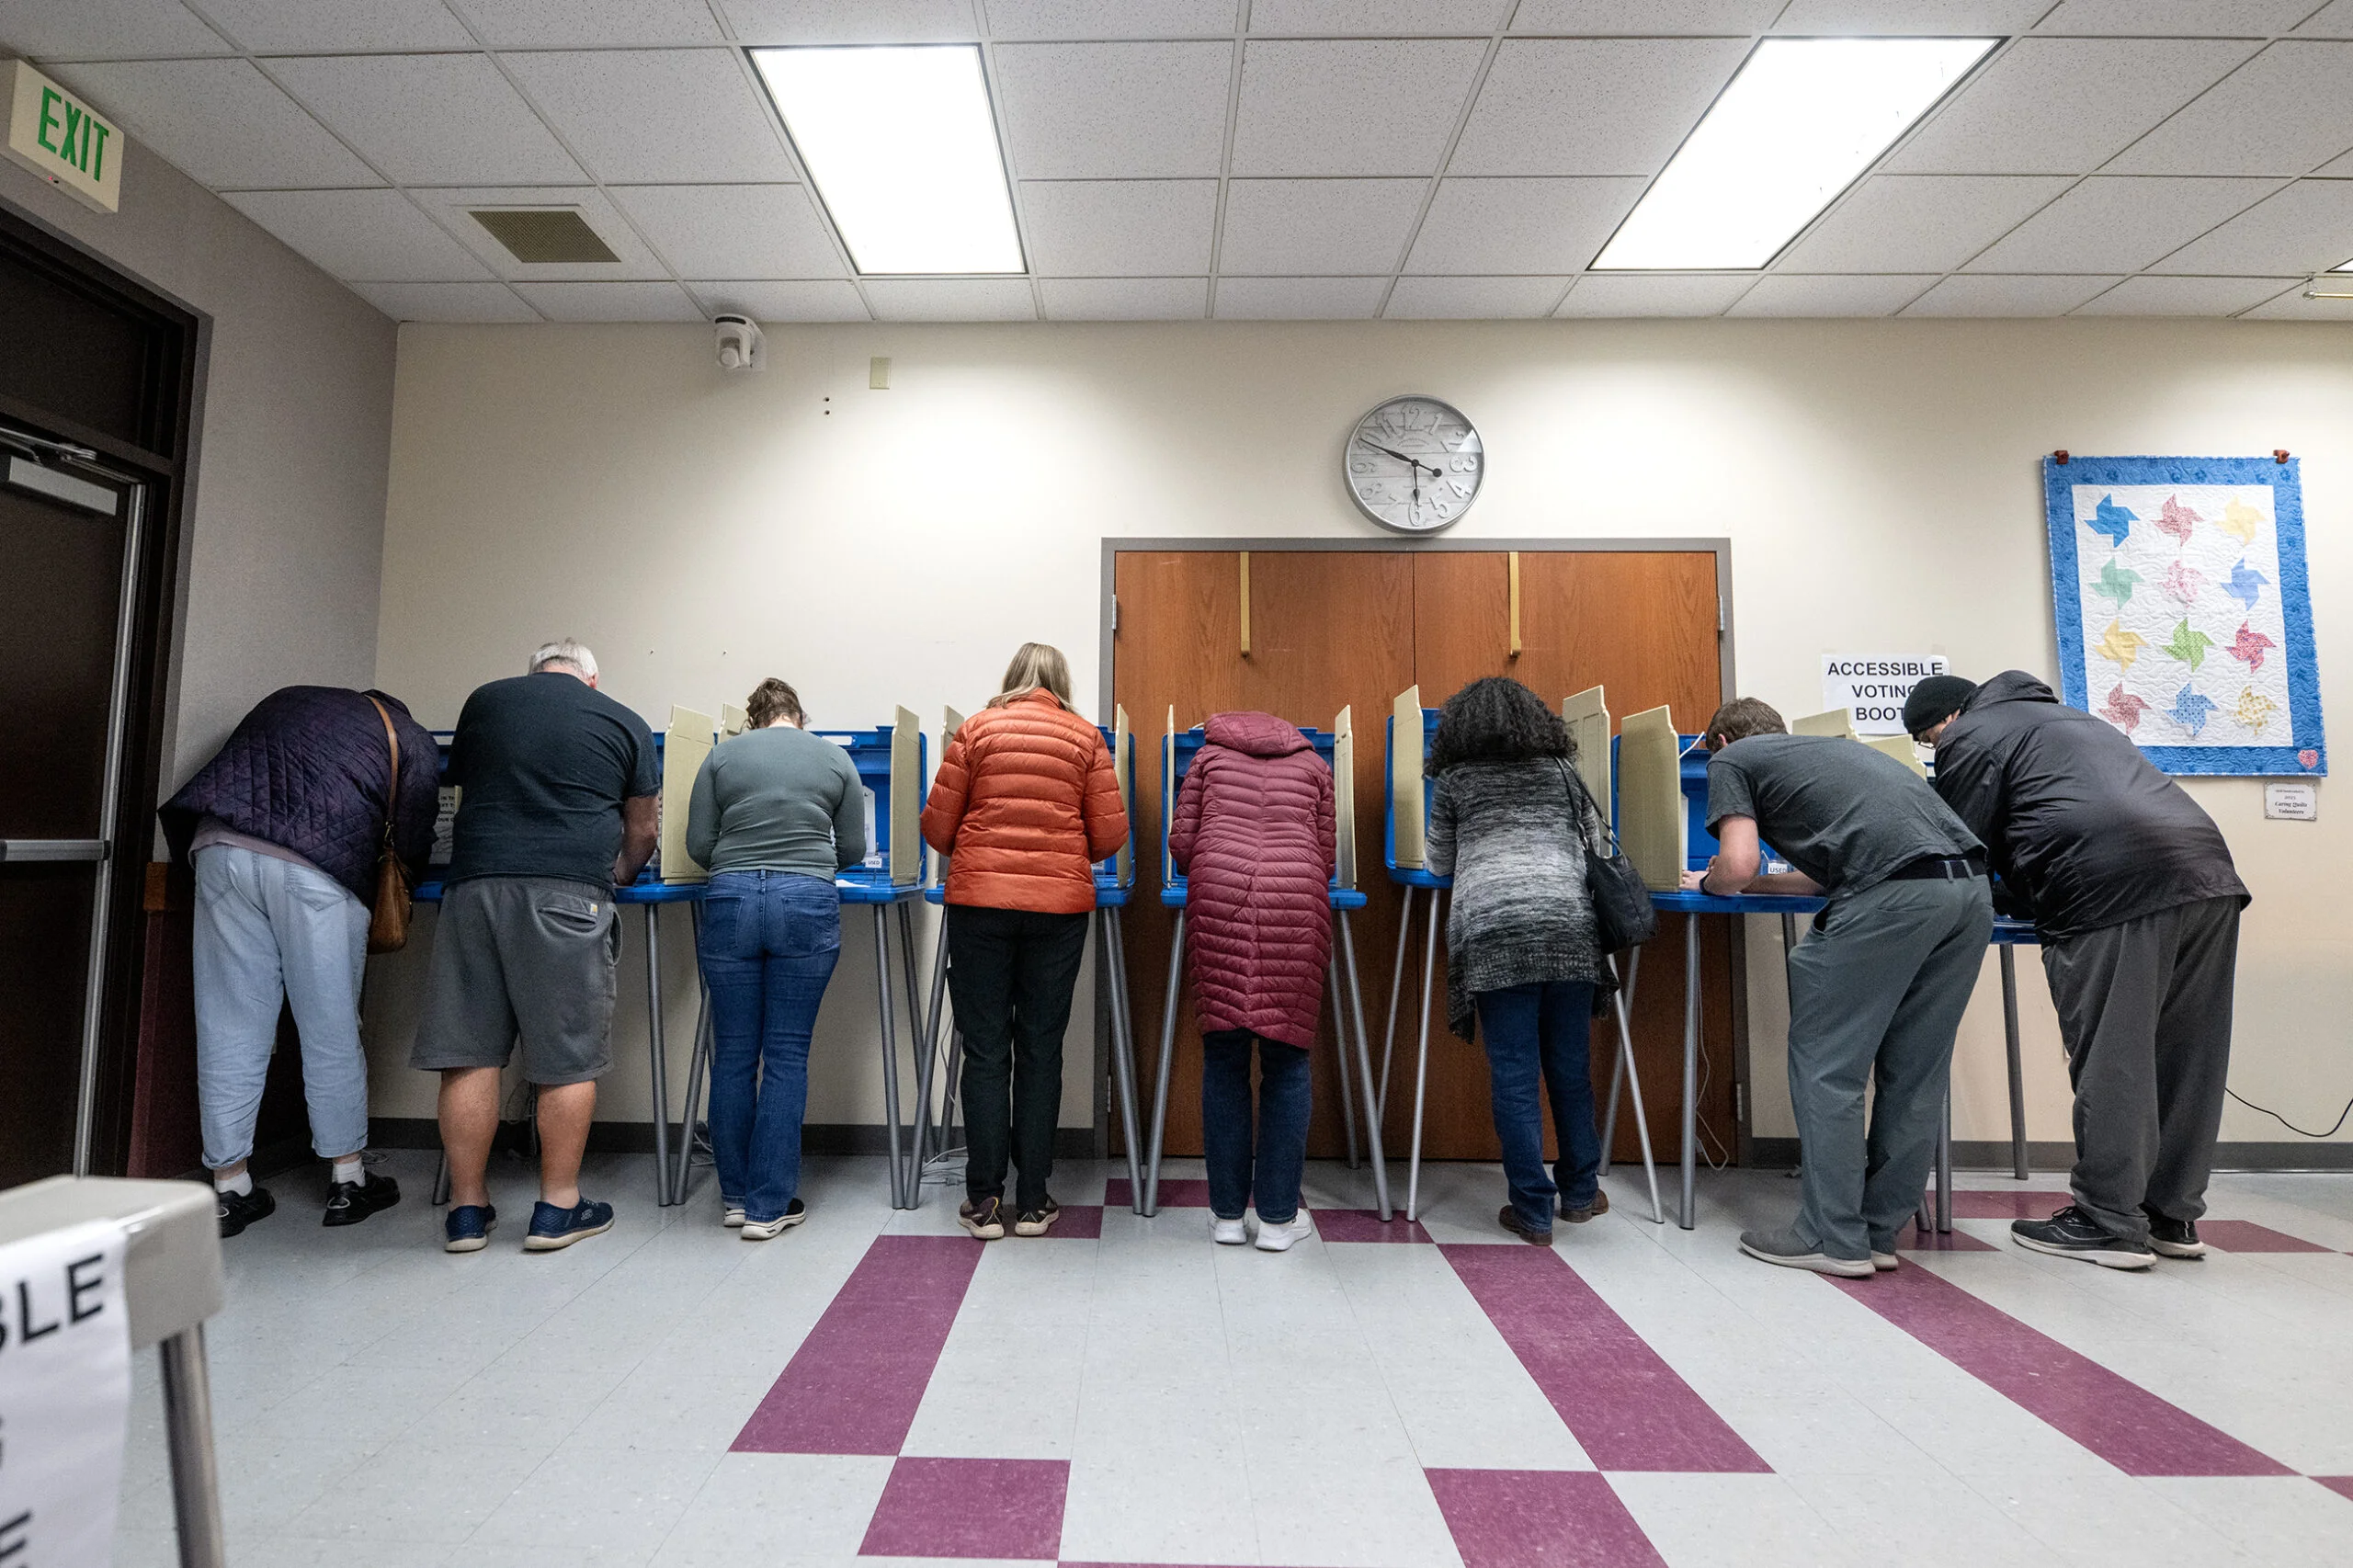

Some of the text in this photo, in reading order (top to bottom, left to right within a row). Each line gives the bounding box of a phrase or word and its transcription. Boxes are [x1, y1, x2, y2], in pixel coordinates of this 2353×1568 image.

[38, 85, 109, 182] EXIT
[1828, 663, 1944, 676] ACCESSIBLE
[0, 1253, 104, 1350] LE
